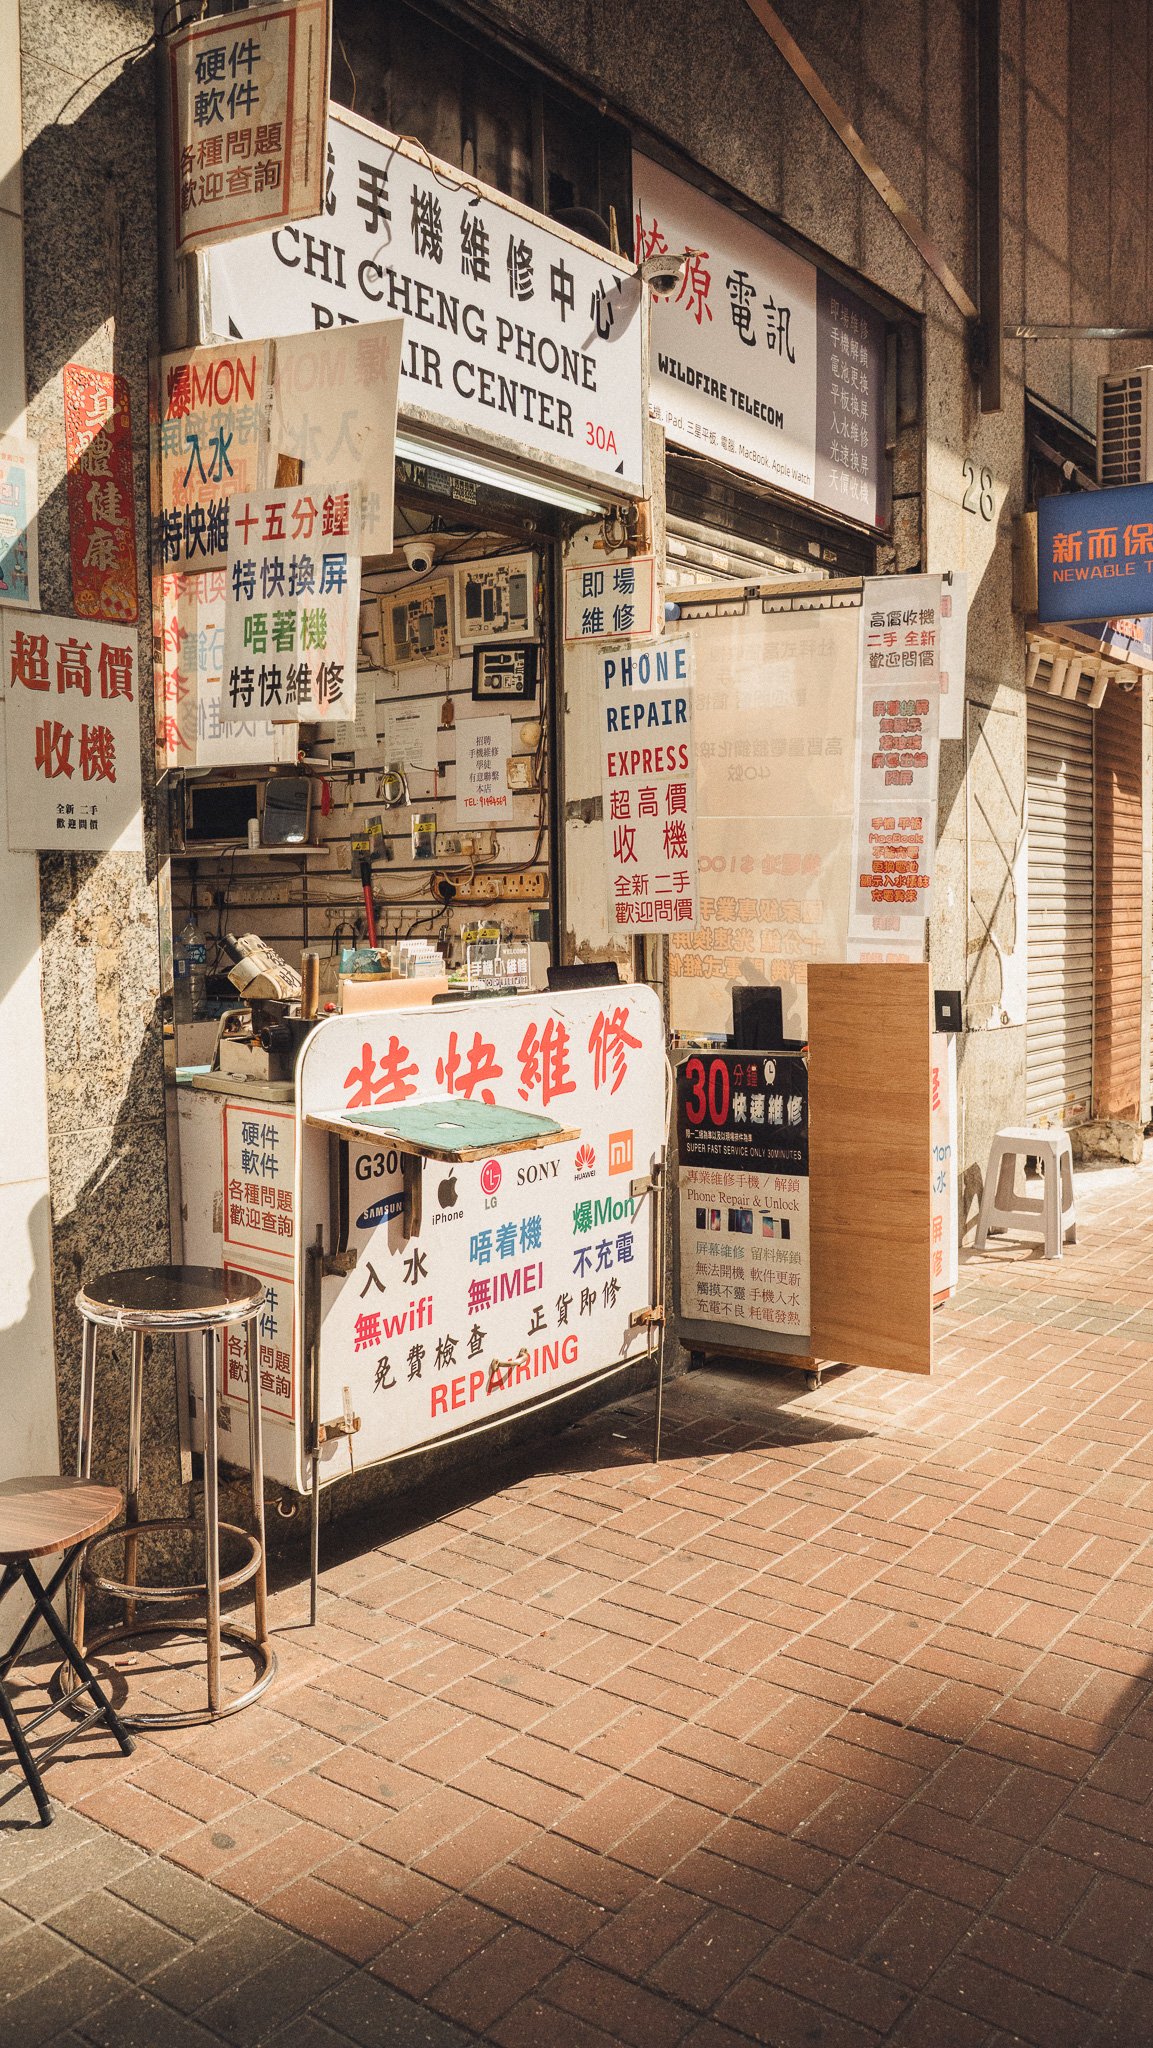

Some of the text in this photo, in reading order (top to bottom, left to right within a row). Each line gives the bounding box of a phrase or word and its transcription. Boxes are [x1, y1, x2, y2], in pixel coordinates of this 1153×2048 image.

[195, 38, 261, 84] 硬件
[193, 80, 260, 128] 軟件
[180, 121, 283, 177] 各種問題
[180, 159, 283, 215] 歡迎查詢
[271, 225, 597, 393] CHI CHENG PHONE
[166, 355, 256, 421] 爆MON
[658, 352, 784, 430] WILDFIRE TELECOM
[830, 355, 869, 396] 電池更換
[452, 359, 574, 438] CENTER
[585, 421, 618, 455] 30A
[830, 410, 868, 448] 入水維修
[182, 426, 234, 488] 入水
[771, 459, 791, 478] Apple
[792, 467, 811, 486] Watch
[75, 384, 124, 572] 身體健康
[962, 457, 994, 522] 28
[160, 496, 230, 563] 特快維
[232, 553, 347, 601] 特快換屏
[582, 567, 635, 598] 即場
[1053, 561, 1136, 583] NEWABLE
[243, 607, 327, 654] 唔著機
[581, 603, 635, 635] 維修
[870, 609, 935, 628] 高價收機
[867, 630, 936, 647] 二手 全新
[10, 630, 134, 702] 超高價
[604, 648, 687, 690] PHONE
[869, 650, 934, 669] 歡迎問價
[228, 661, 344, 708] 特快維修
[606, 698, 688, 733] REPAIR
[34, 719, 117, 783] 收機
[469, 747, 499, 759] 手機維修
[607, 743, 689, 778] EXPRESS
[56, 803, 98, 816] 全新 二手
[609, 782, 688, 820] 超高價
[56, 817, 99, 831] 歡迎問價
[613, 820, 689, 864] 收機
[868, 832, 924, 844] MacBook
[613, 870, 690, 897] 全新 二手
[614, 898, 694, 925] 歡迎問價
[344, 1006, 643, 1108] 特快維修
[685, 1057, 730, 1126] 30
[732, 1091, 803, 1126] 快速維修
[241, 1121, 279, 1150] 硬件
[686, 1142, 706, 1153] SUPER
[707, 1143, 722, 1154] FAST
[723, 1145, 748, 1157] SERVICE
[749, 1147, 765, 1158] ONLY
[241, 1149, 279, 1179] 軟件
[516, 1159, 561, 1186] SONY
[574, 1169, 596, 1181] HUAWEI
[687, 1169, 760, 1190] 專業維修手機
[774, 1176, 800, 1193] 解鎖
[228, 1178, 293, 1213] 各種問題
[363, 1200, 403, 1220] SAMSUN
[484, 1196, 498, 1210] LG
[687, 1188, 716, 1203] Phone
[718, 1191, 751, 1207] Repair
[765, 1196, 800, 1212] Unlock
[229, 1203, 293, 1238] 歡迎查詢
[432, 1209, 464, 1226] iPhone
[572, 1196, 635, 1236] 爆Mon
[469, 1214, 542, 1266] 唔着機
[572, 1231, 634, 1279] 不充電
[359, 1247, 429, 1298] 入水
[467, 1261, 543, 1315] 無IMEI
[750, 1267, 800, 1287] 軟件更新
[264, 1284, 279, 1312] 件
[527, 1276, 622, 1336] 正貨即修
[696, 1298, 745, 1318] 充電不良
[749, 1288, 800, 1307] 手機入水
[353, 1295, 433, 1353] 無wifi
[372, 1322, 487, 1394] 免費檢查
[430, 1334, 579, 1418] REPAIRING
[228, 1358, 291, 1399] 歡查詢
